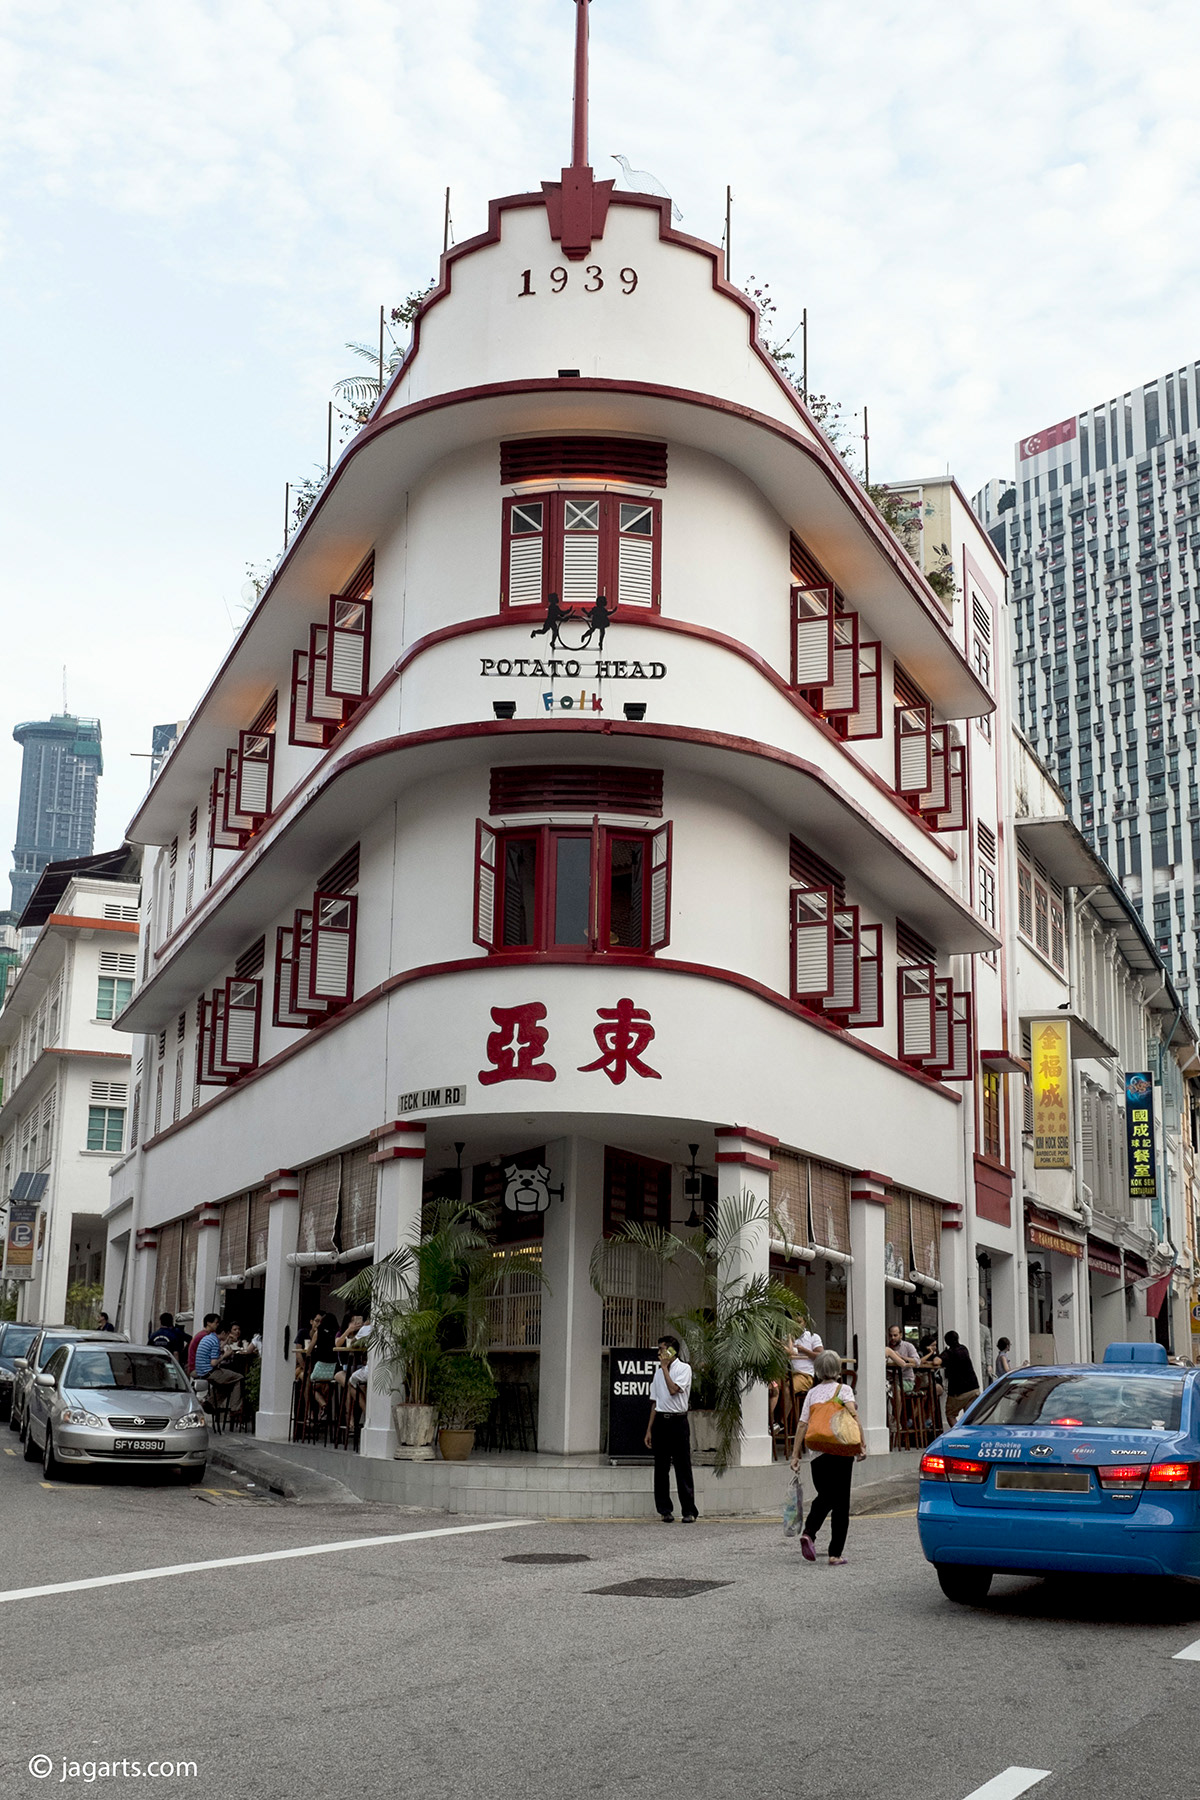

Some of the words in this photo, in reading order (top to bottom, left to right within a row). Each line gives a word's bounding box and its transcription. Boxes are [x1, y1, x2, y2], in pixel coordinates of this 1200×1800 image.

[518, 265, 638, 297] 1939
[480, 659, 581, 678] POTATO
[595, 660, 667, 680] HEAD
[542, 690, 604, 711] Folk
[400, 1092, 419, 1111] TECK
[422, 1090, 440, 1107] LIM
[445, 1087, 460, 1104] RD
[1130, 1178, 1142, 1186] KOK
[613, 1382, 649, 1395] SERVI
[115, 1440, 164, 1451] SFY8399U
[981, 1441, 993, 1449] Cab
[994, 1441, 1022, 1451] Booking
[977, 1448, 1003, 1458] 6552
